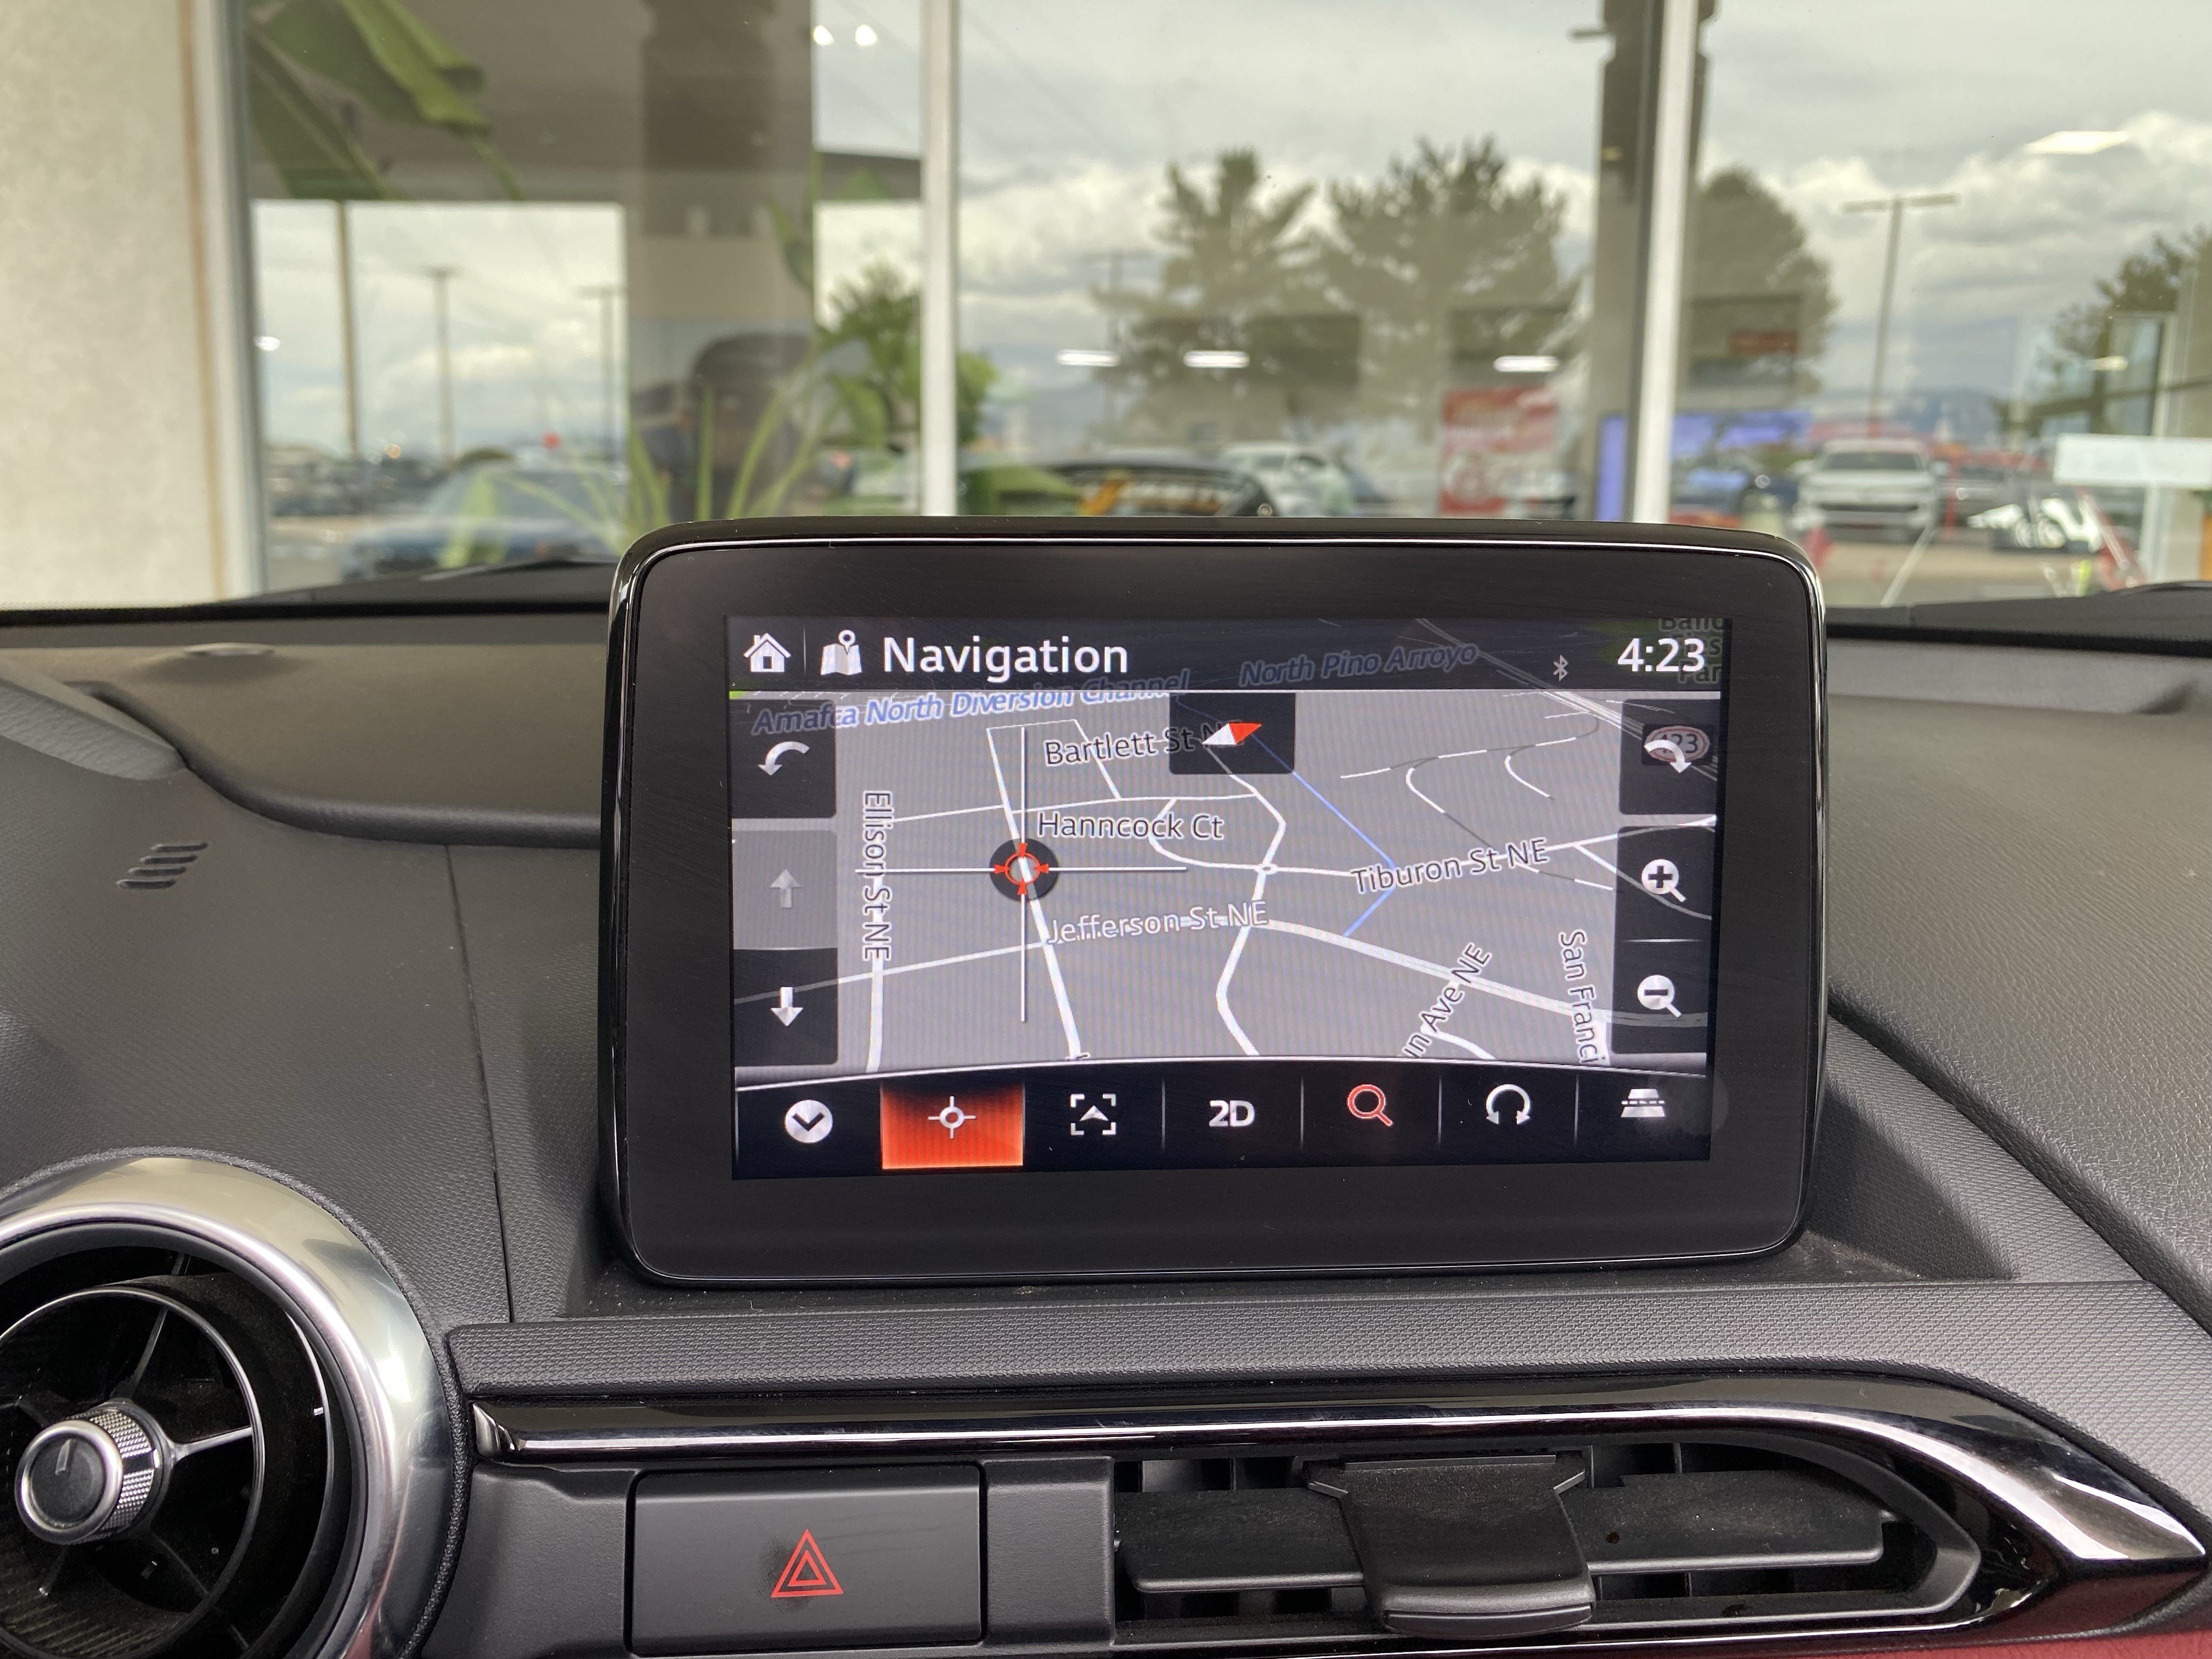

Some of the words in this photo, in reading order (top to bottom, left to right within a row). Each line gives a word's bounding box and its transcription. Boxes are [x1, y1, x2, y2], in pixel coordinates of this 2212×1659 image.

[883, 635, 1128, 683] Navigation
[1239, 655, 1314, 686] North
[1321, 650, 1381, 679] Pino
[1383, 644, 1479, 673] Arroyo
[1617, 637, 1705, 672] 4:23
[865, 692, 944, 725] North
[950, 681, 1074, 717] Diversion
[1080, 668, 1190, 704] Channel
[1045, 732, 1156, 766] Bartlett
[1164, 727, 1196, 752] St
[864, 791, 894, 878] Ellison
[1037, 811, 1184, 839] Hanncock
[1191, 813, 1224, 840] Ct
[1351, 862, 1463, 894] Tiburon
[1467, 847, 1502, 874] St
[1505, 837, 1549, 868] NE
[863, 887, 893, 915] St
[863, 922, 891, 961] NE
[1048, 914, 1181, 944] Jefferson
[1189, 906, 1219, 931] St
[1227, 901, 1269, 927] NE
[1559, 929, 1587, 981] San
[1419, 986, 1465, 1034] Ave
[1451, 943, 1492, 984] NE
[1209, 1100, 1255, 1127] 2D
